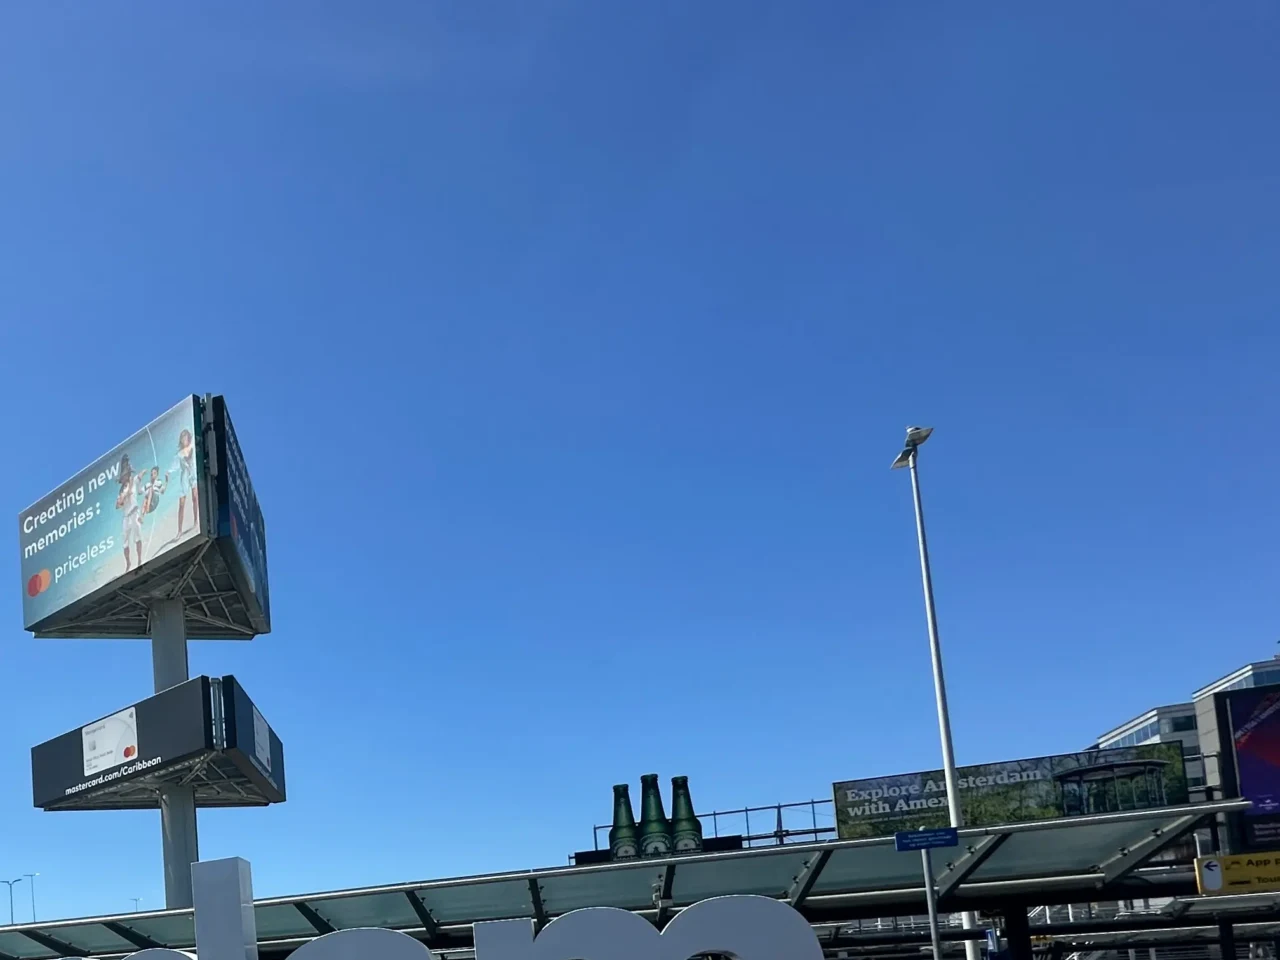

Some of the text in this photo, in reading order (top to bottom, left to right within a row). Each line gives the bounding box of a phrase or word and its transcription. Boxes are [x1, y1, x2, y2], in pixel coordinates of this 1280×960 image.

[23, 460, 121, 534] Creating new
[54, 534, 115, 583] priceless
[65, 756, 162, 795] mastercard.com/Caribbean
[846, 784, 920, 802] Explore
[847, 795, 950, 817] with Amex
[1246, 858, 1271, 867] App
